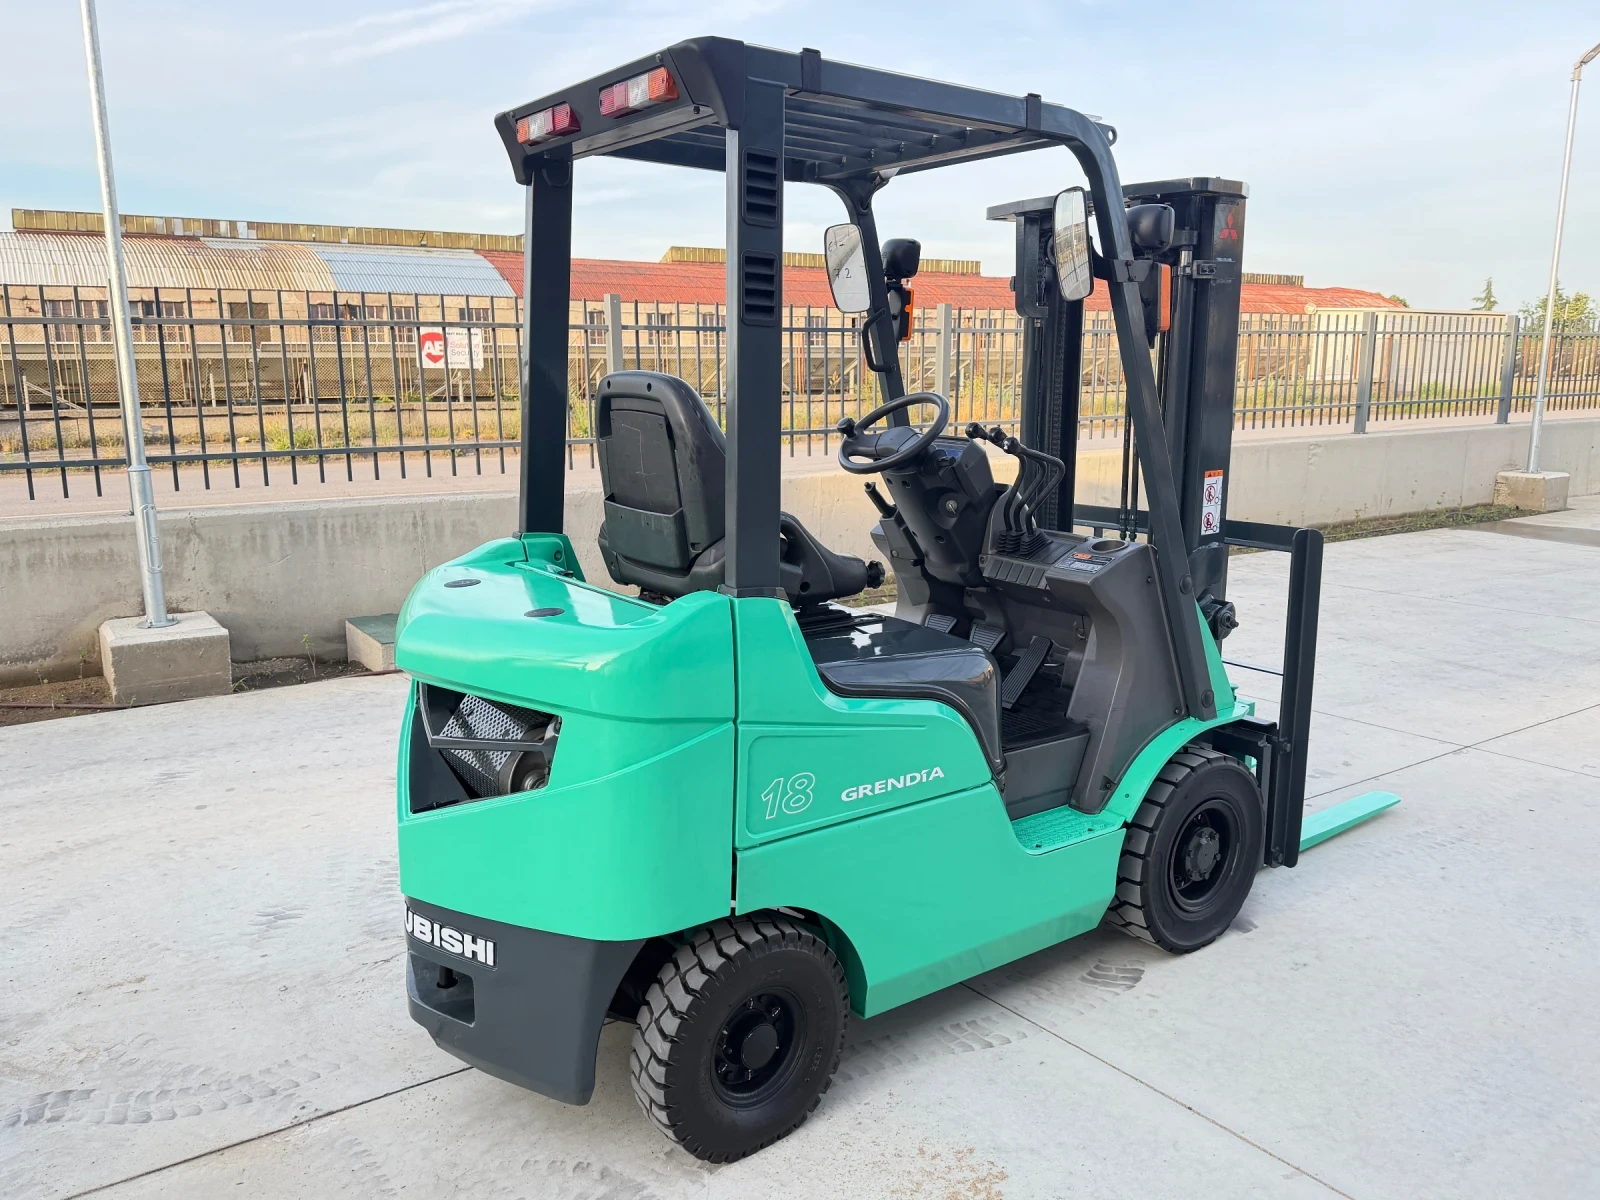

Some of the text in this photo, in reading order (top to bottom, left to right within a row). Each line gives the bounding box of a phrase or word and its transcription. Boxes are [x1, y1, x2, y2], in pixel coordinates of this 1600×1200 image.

[450, 341, 480, 349] Soluon
[451, 349, 480, 357] Secuty
[761, 771, 816, 820] 18
